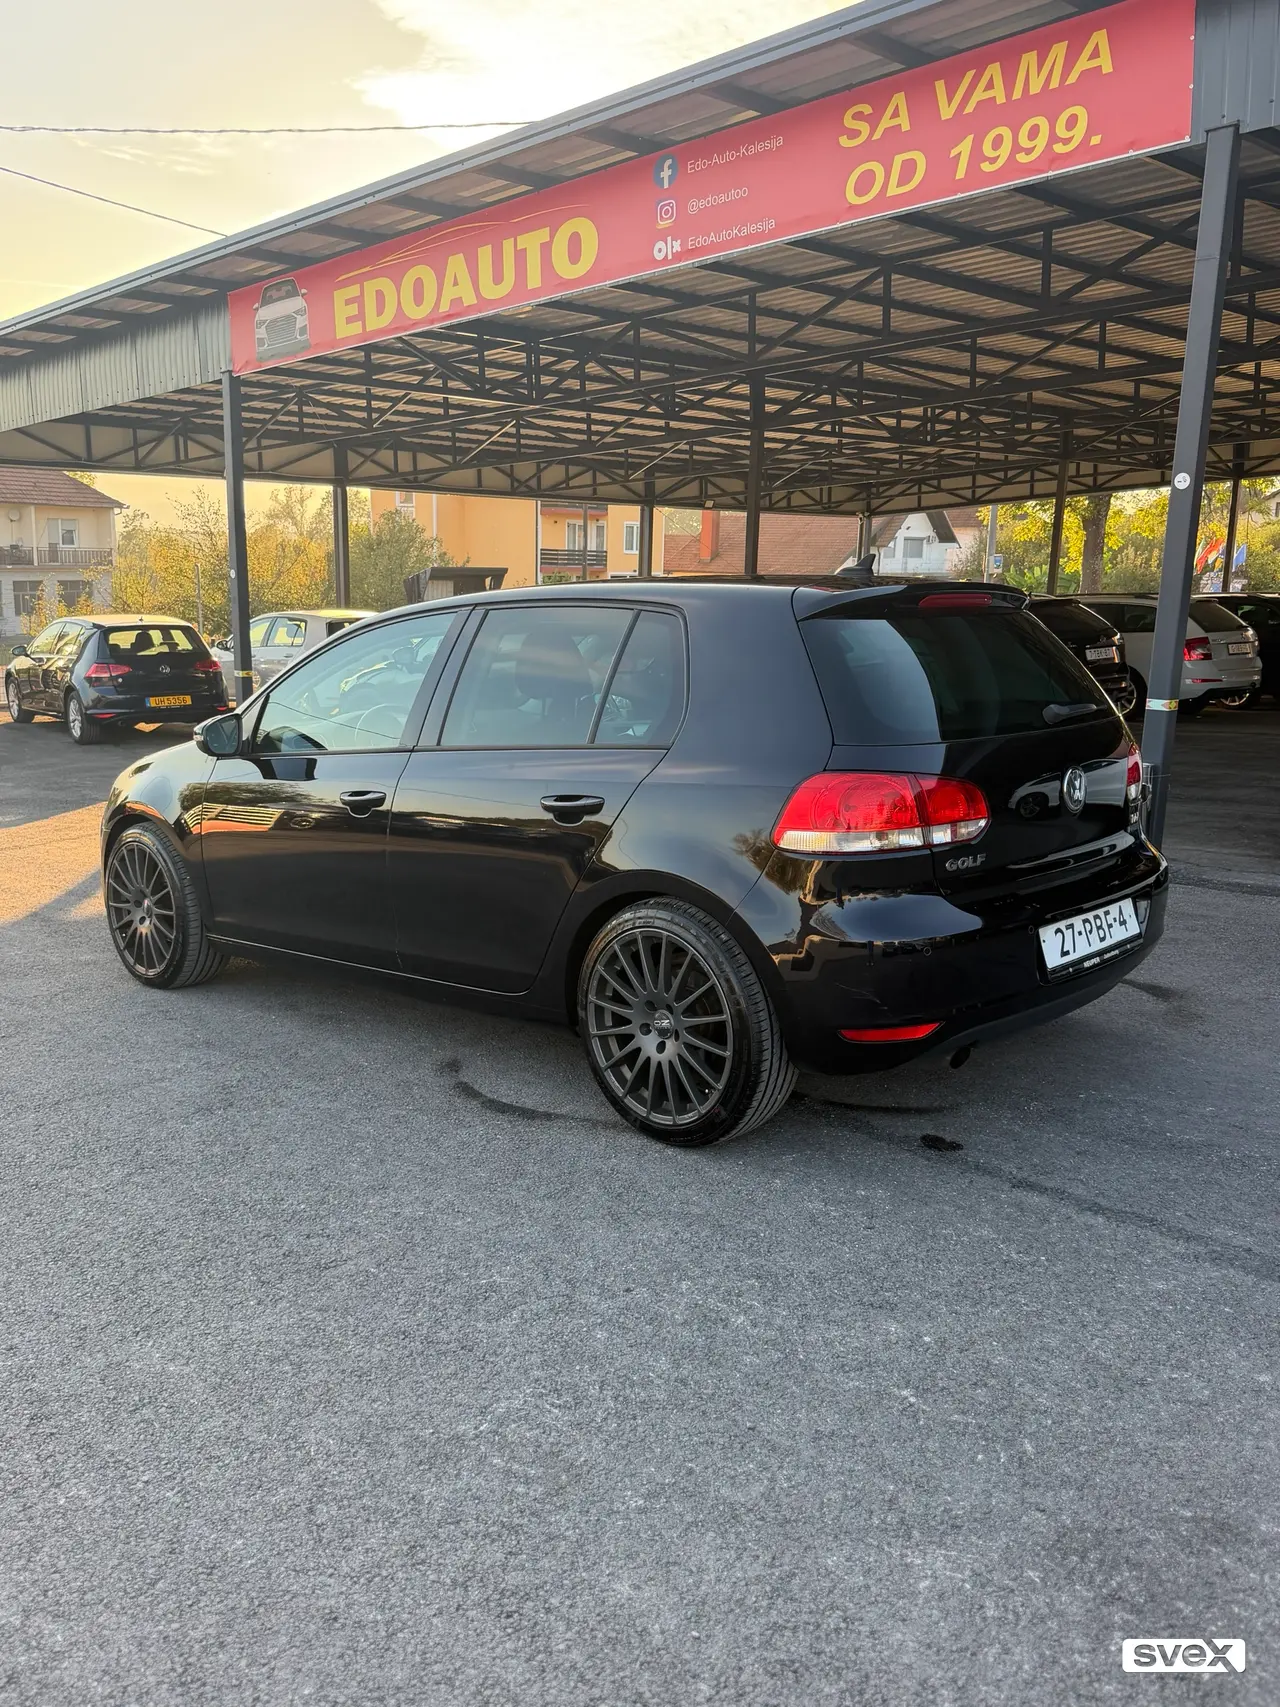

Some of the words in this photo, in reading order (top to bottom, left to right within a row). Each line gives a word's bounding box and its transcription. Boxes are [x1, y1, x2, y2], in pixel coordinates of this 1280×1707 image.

[838, 92, 911, 148] SA
[934, 28, 1113, 121] VAMA
[687, 135, 784, 173] Edo-Auto-Kalesija
[844, 151, 927, 205] OD
[949, 104, 1102, 180] 1999.
[687, 187, 749, 215] @edoautoo
[687, 217, 776, 250] EdoAutoKalesija
[332, 216, 599, 339] EDOAUTO
[945, 853, 987, 872] GOLF
[1054, 904, 1129, 959] 27-PBF-4
